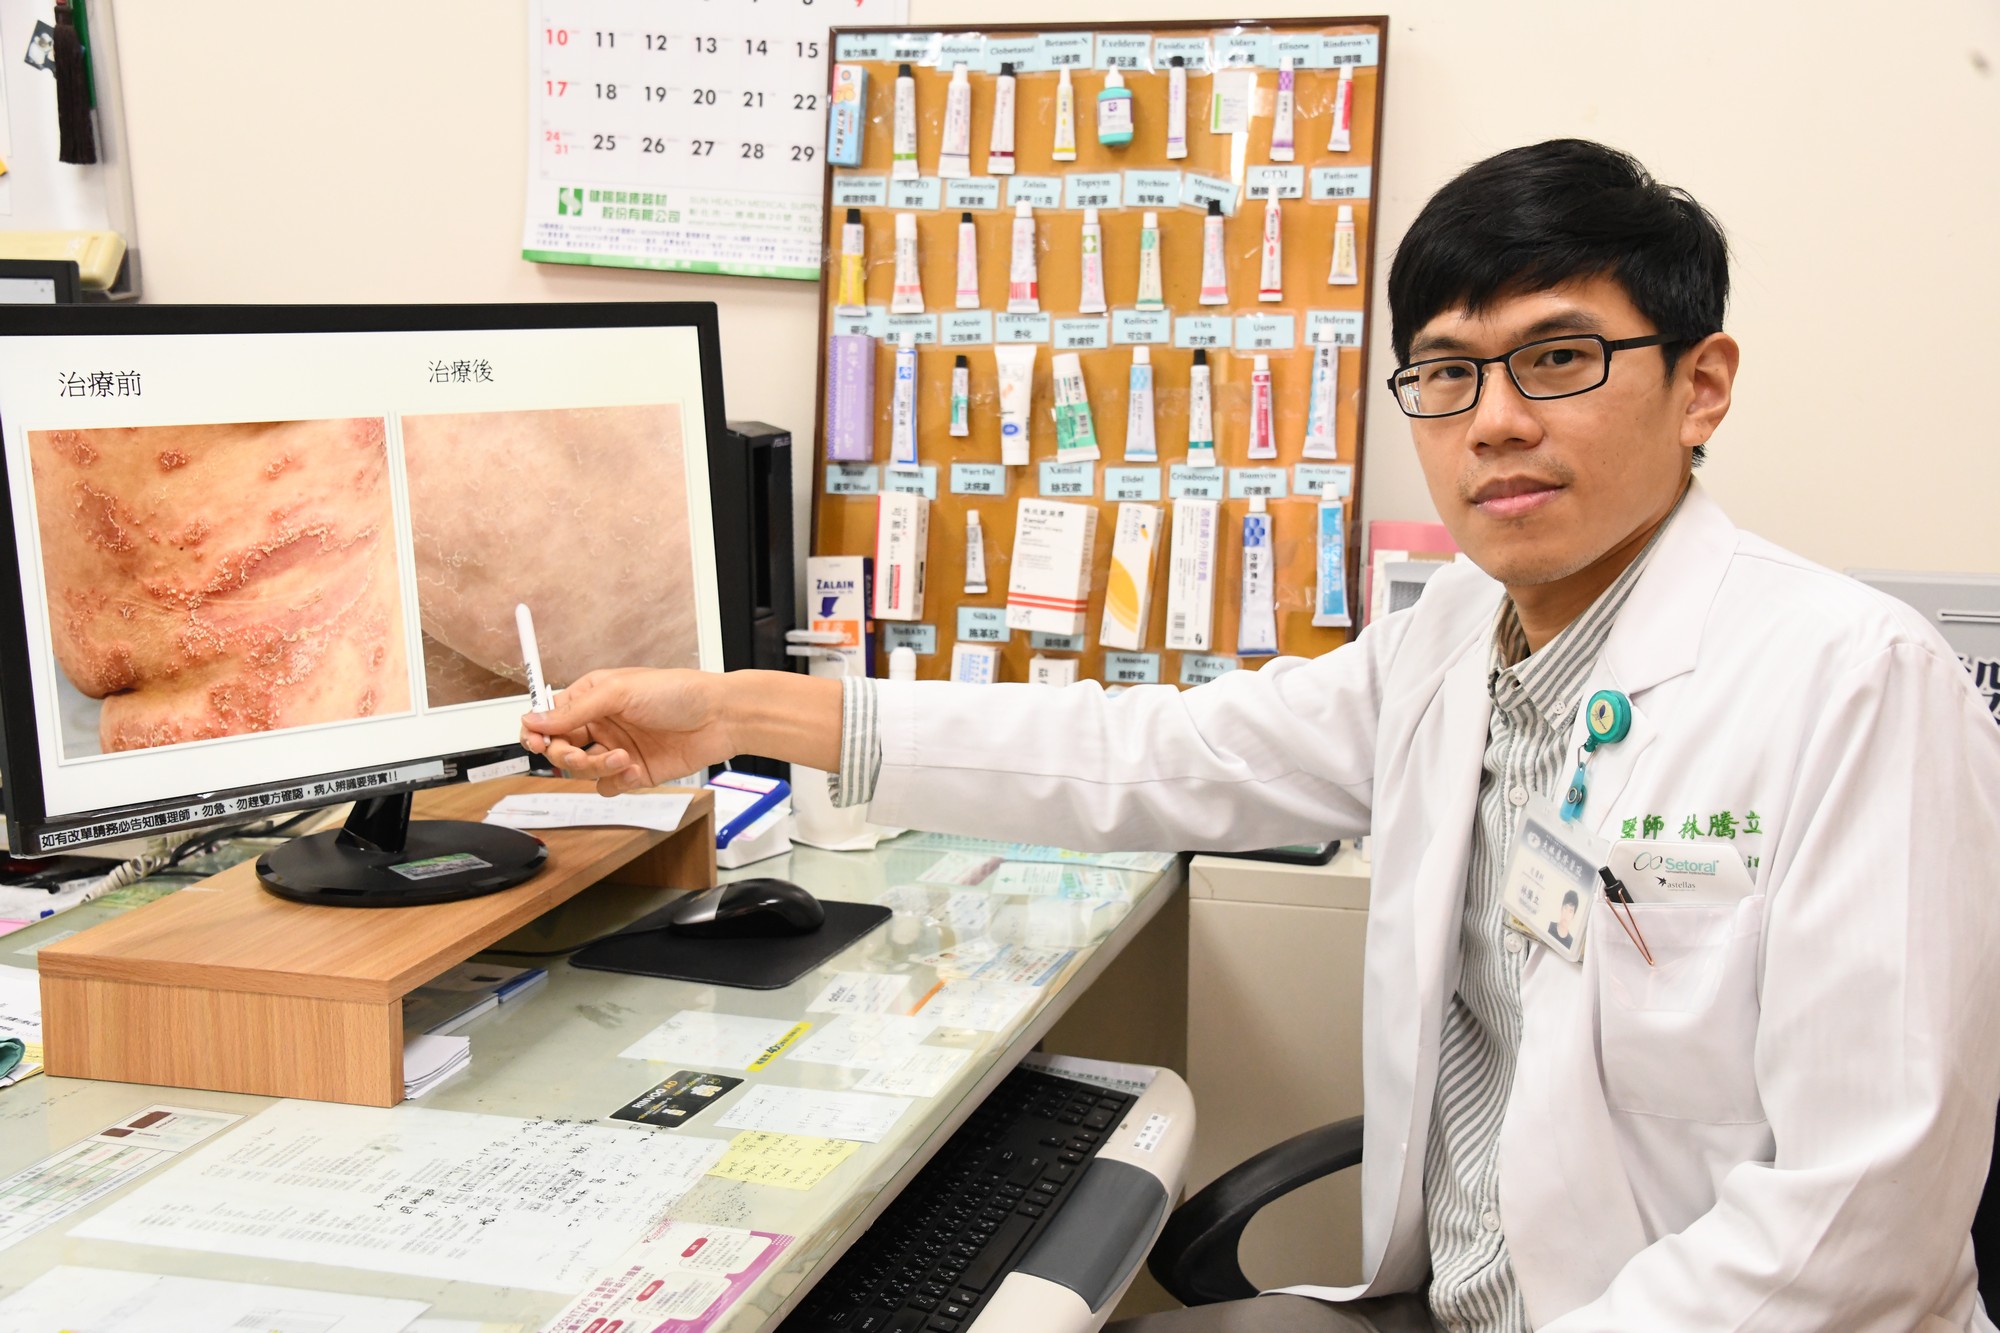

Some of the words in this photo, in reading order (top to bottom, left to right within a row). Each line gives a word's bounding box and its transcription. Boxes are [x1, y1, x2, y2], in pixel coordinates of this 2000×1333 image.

[546, 29, 568, 46] 10
[596, 32, 614, 48] 11
[645, 34, 667, 50] 12
[695, 37, 717, 53] 13
[745, 40, 768, 56] 14
[797, 42, 818, 58] 15
[1101, 39, 1145, 48] Exelderm
[546, 81, 568, 97] 17
[595, 83, 617, 100] 18
[645, 86, 667, 103] 19
[693, 89, 716, 105] 20
[743, 92, 763, 108] 21
[793, 94, 817, 110] 22
[545, 131, 560, 142] 24
[593, 134, 616, 151] 25
[642, 137, 665, 153] 26
[691, 140, 714, 156] 27
[741, 142, 764, 159] 28
[791, 145, 815, 162] 29
[555, 144, 568, 154] 31
[602, 206, 681, 224] 股份有限公司
[428, 359, 494, 384] 治療後
[58, 369, 142, 399] 治療前
[816, 579, 855, 590] ZALAIN
[1620, 814, 1665, 841] 醫師
[1678, 810, 1763, 841] 林騰立
[1665, 857, 1716, 873] Setoral
[1667, 880, 1696, 889] astellas
